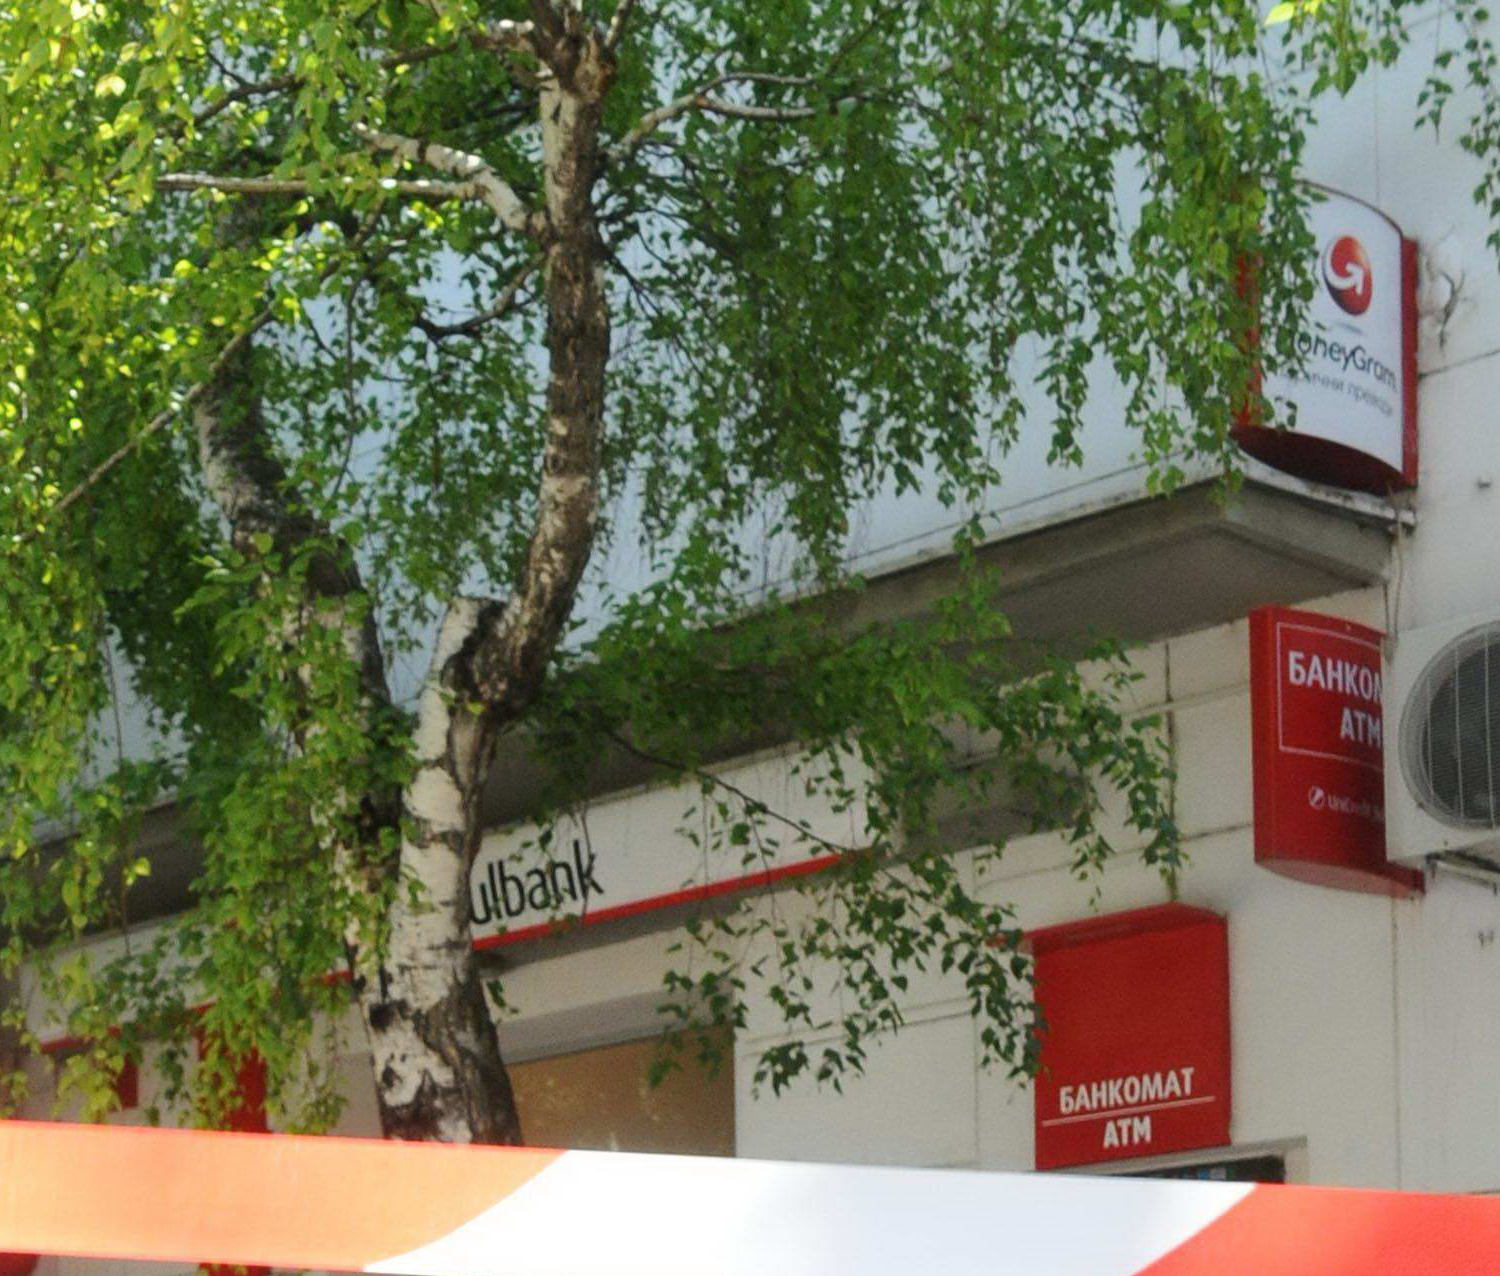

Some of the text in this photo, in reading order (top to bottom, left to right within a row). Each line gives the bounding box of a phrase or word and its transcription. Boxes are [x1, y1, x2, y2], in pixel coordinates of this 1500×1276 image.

[1293, 332, 1398, 393] oneyGram
[1340, 706, 1382, 749] ATM
[1059, 1067, 1195, 1114] БАНКОМАТ
[1102, 1115, 1151, 1148] ATM
